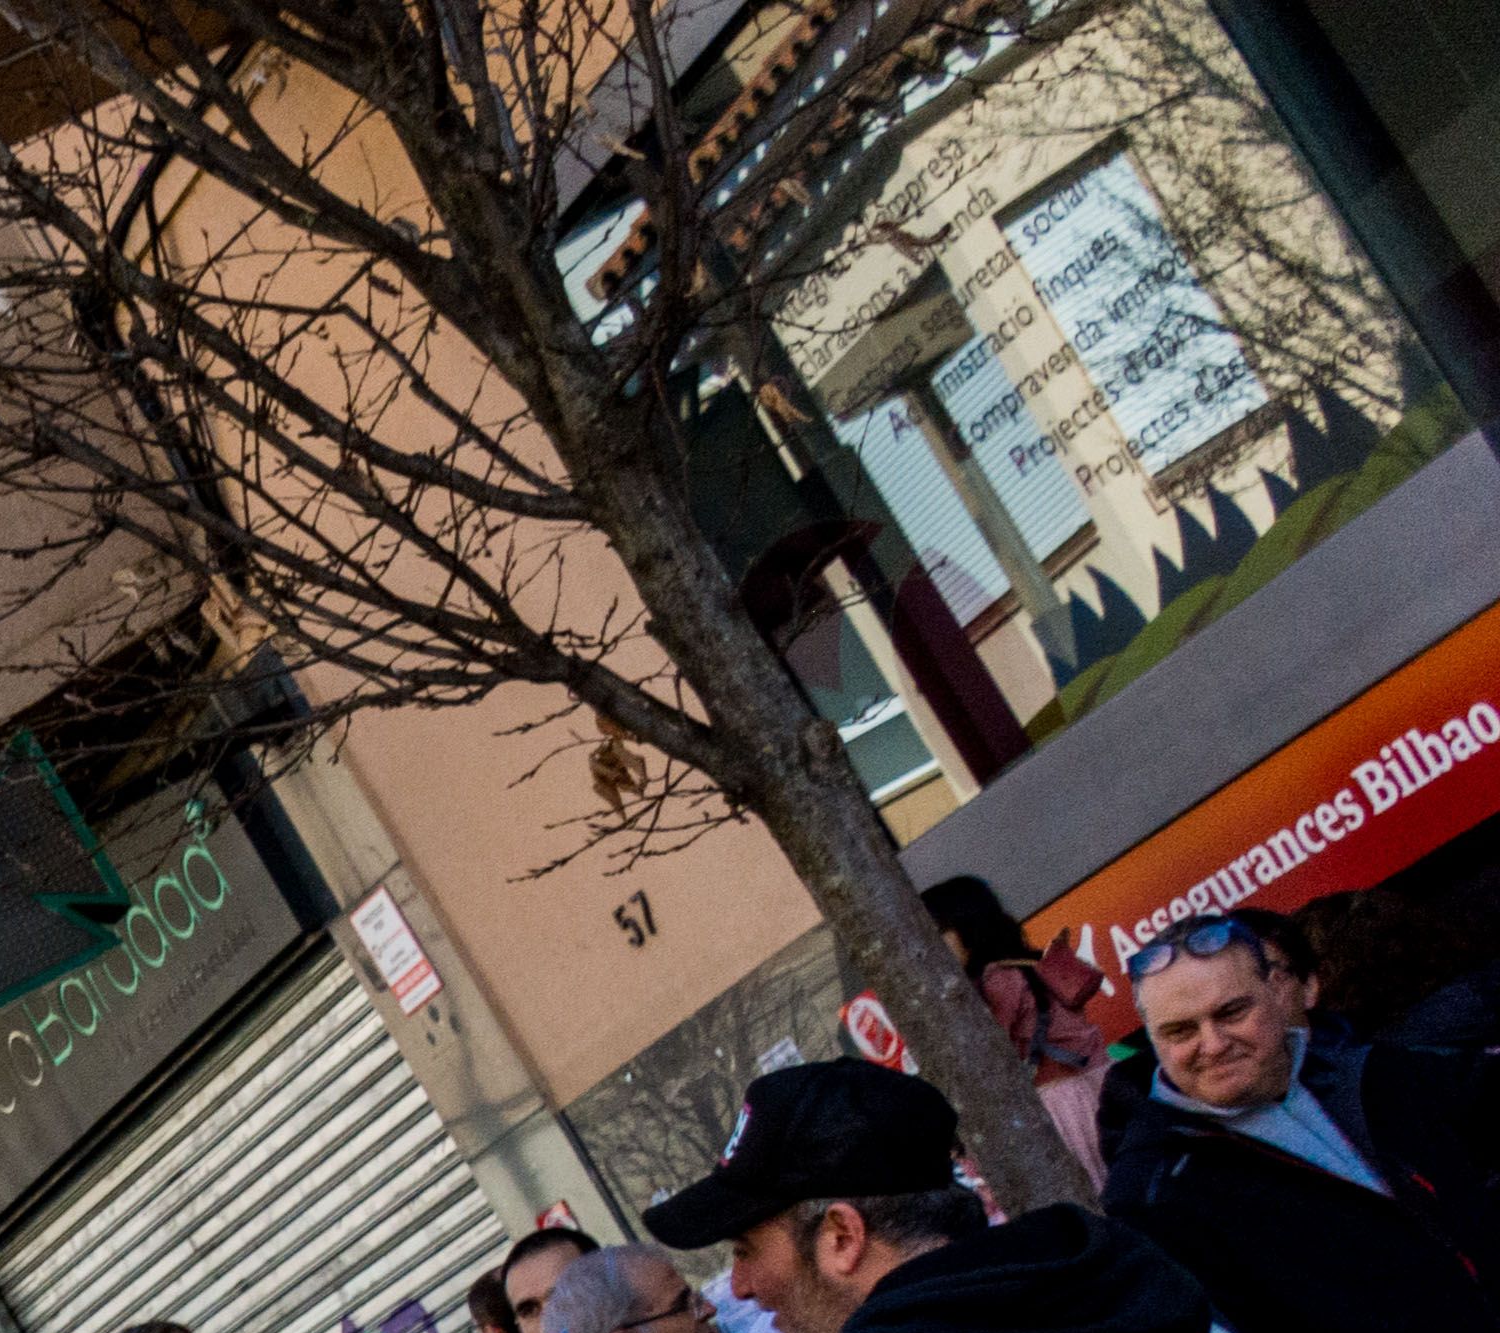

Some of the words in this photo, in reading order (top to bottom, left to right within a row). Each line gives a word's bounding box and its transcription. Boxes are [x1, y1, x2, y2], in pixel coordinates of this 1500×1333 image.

[1020, 179, 1089, 246] social
[1031, 228, 1122, 309] finques
[1006, 381, 1122, 476] Projectes
[1073, 398, 1191, 497] Projectes
[1351, 701, 1500, 816] Bilbao
[613, 891, 659, 948] 57
